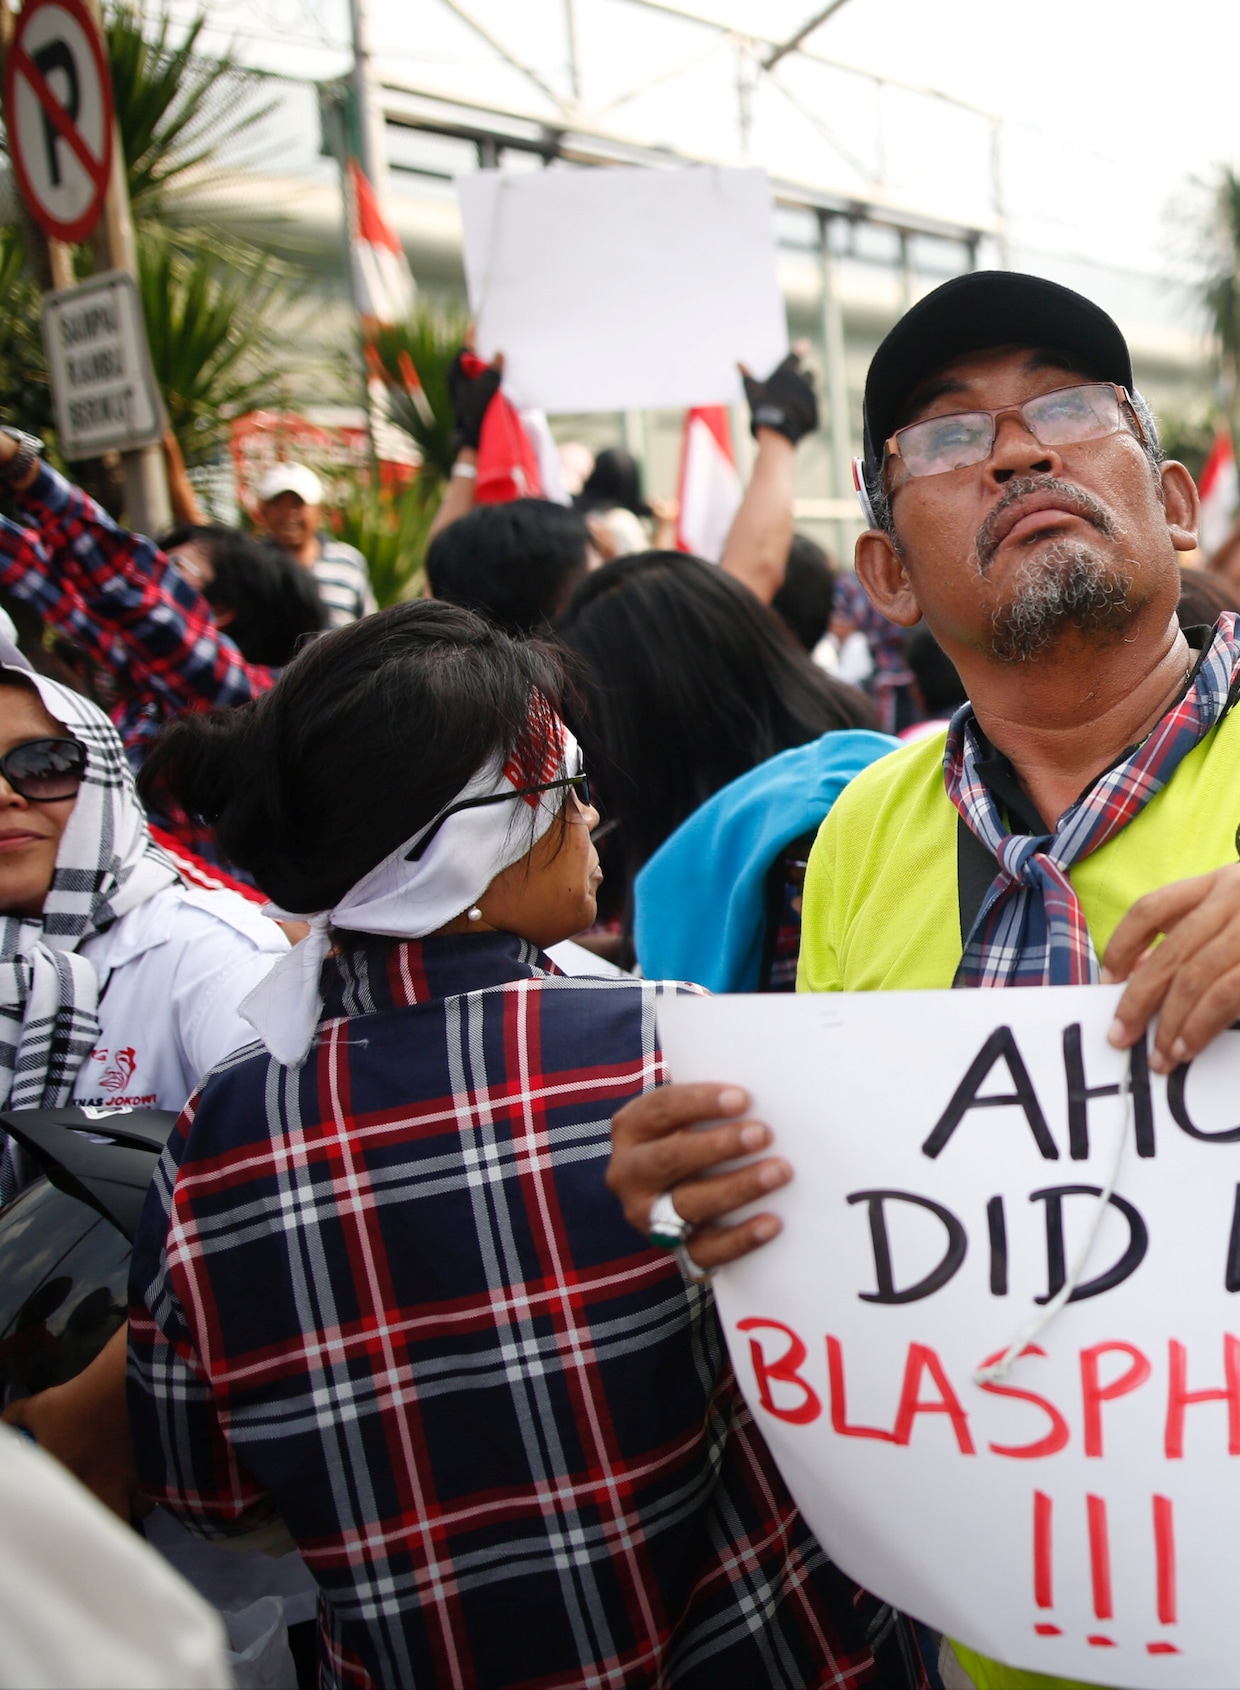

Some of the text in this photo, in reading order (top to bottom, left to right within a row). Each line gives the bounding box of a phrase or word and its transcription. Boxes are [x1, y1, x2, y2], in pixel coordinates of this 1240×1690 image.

[105, 1094, 157, 1106] JOKOWI
[847, 1185, 1148, 1306] DID
[1033, 1490, 1180, 1655] !!!
